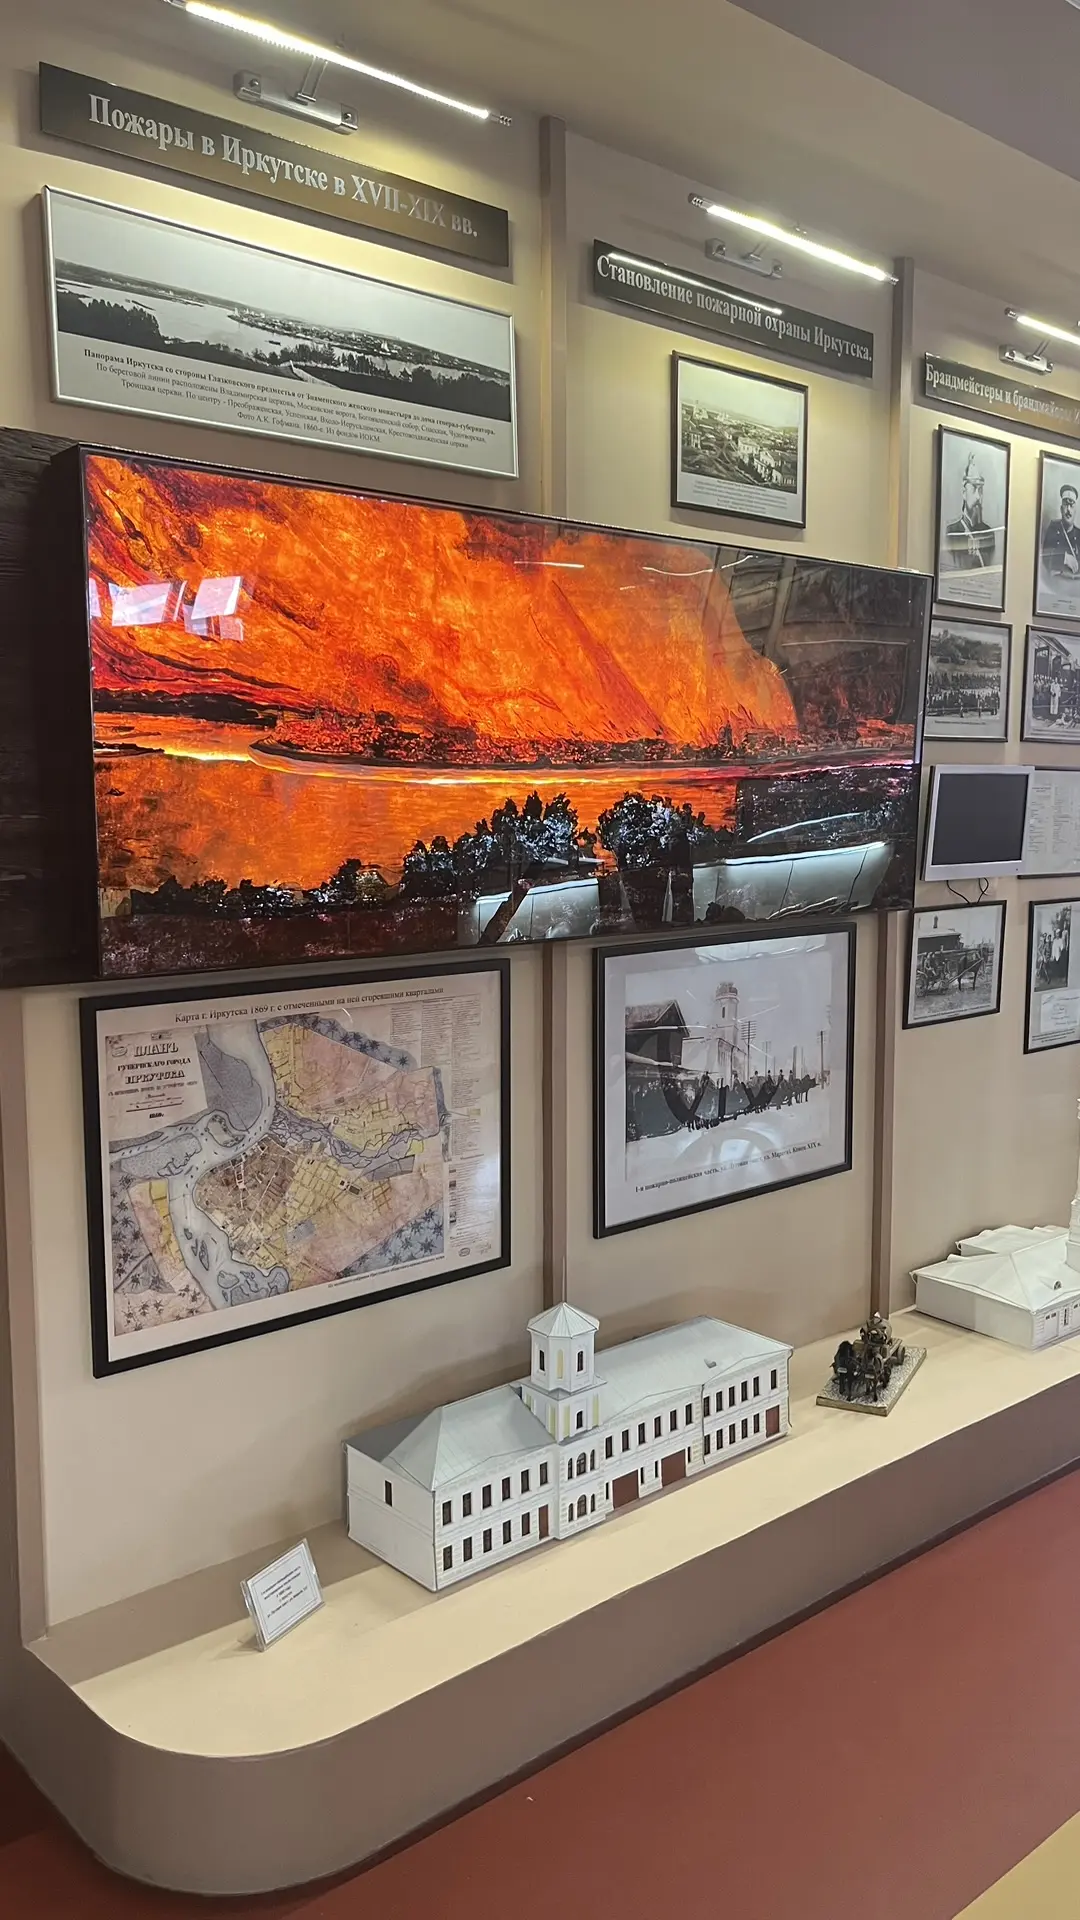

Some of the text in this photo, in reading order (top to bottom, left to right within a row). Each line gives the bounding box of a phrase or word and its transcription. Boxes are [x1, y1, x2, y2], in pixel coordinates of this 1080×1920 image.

[88, 93, 479, 238] Пожары в Иркутске в XVII-XIX вв.
[596, 254, 873, 362] Становление пожарной охраны Иркутска.
[84, 348, 125, 364] Панорама
[126, 357, 164, 372] Иркутска
[165, 366, 174, 374] со
[175, 369, 207, 381] стороны
[925, 362, 1003, 404] Брандмейстеры
[1005, 386, 1012, 404] и
[96, 362, 108, 372] По
[109, 364, 146, 379] береговой
[171, 378, 219, 393] расположены
[219, 386, 268, 402] Владимирская
[297, 401, 334, 415] Московские
[121, 378, 156, 393] Троицкая
[185, 390, 197, 400] По
[237, 411, 255, 421] Фото
[175, 1012, 200, 1024] Карта
[209, 1009, 248, 1021] Иркутска
[250, 1004, 269, 1014] 1869
[283, 999, 335, 1011] отмеченными
[336, 997, 346, 1005] на
[346, 995, 360, 1004] ней
[361, 991, 404, 1003] сгоревшими
[405, 986, 444, 998] кварталами
